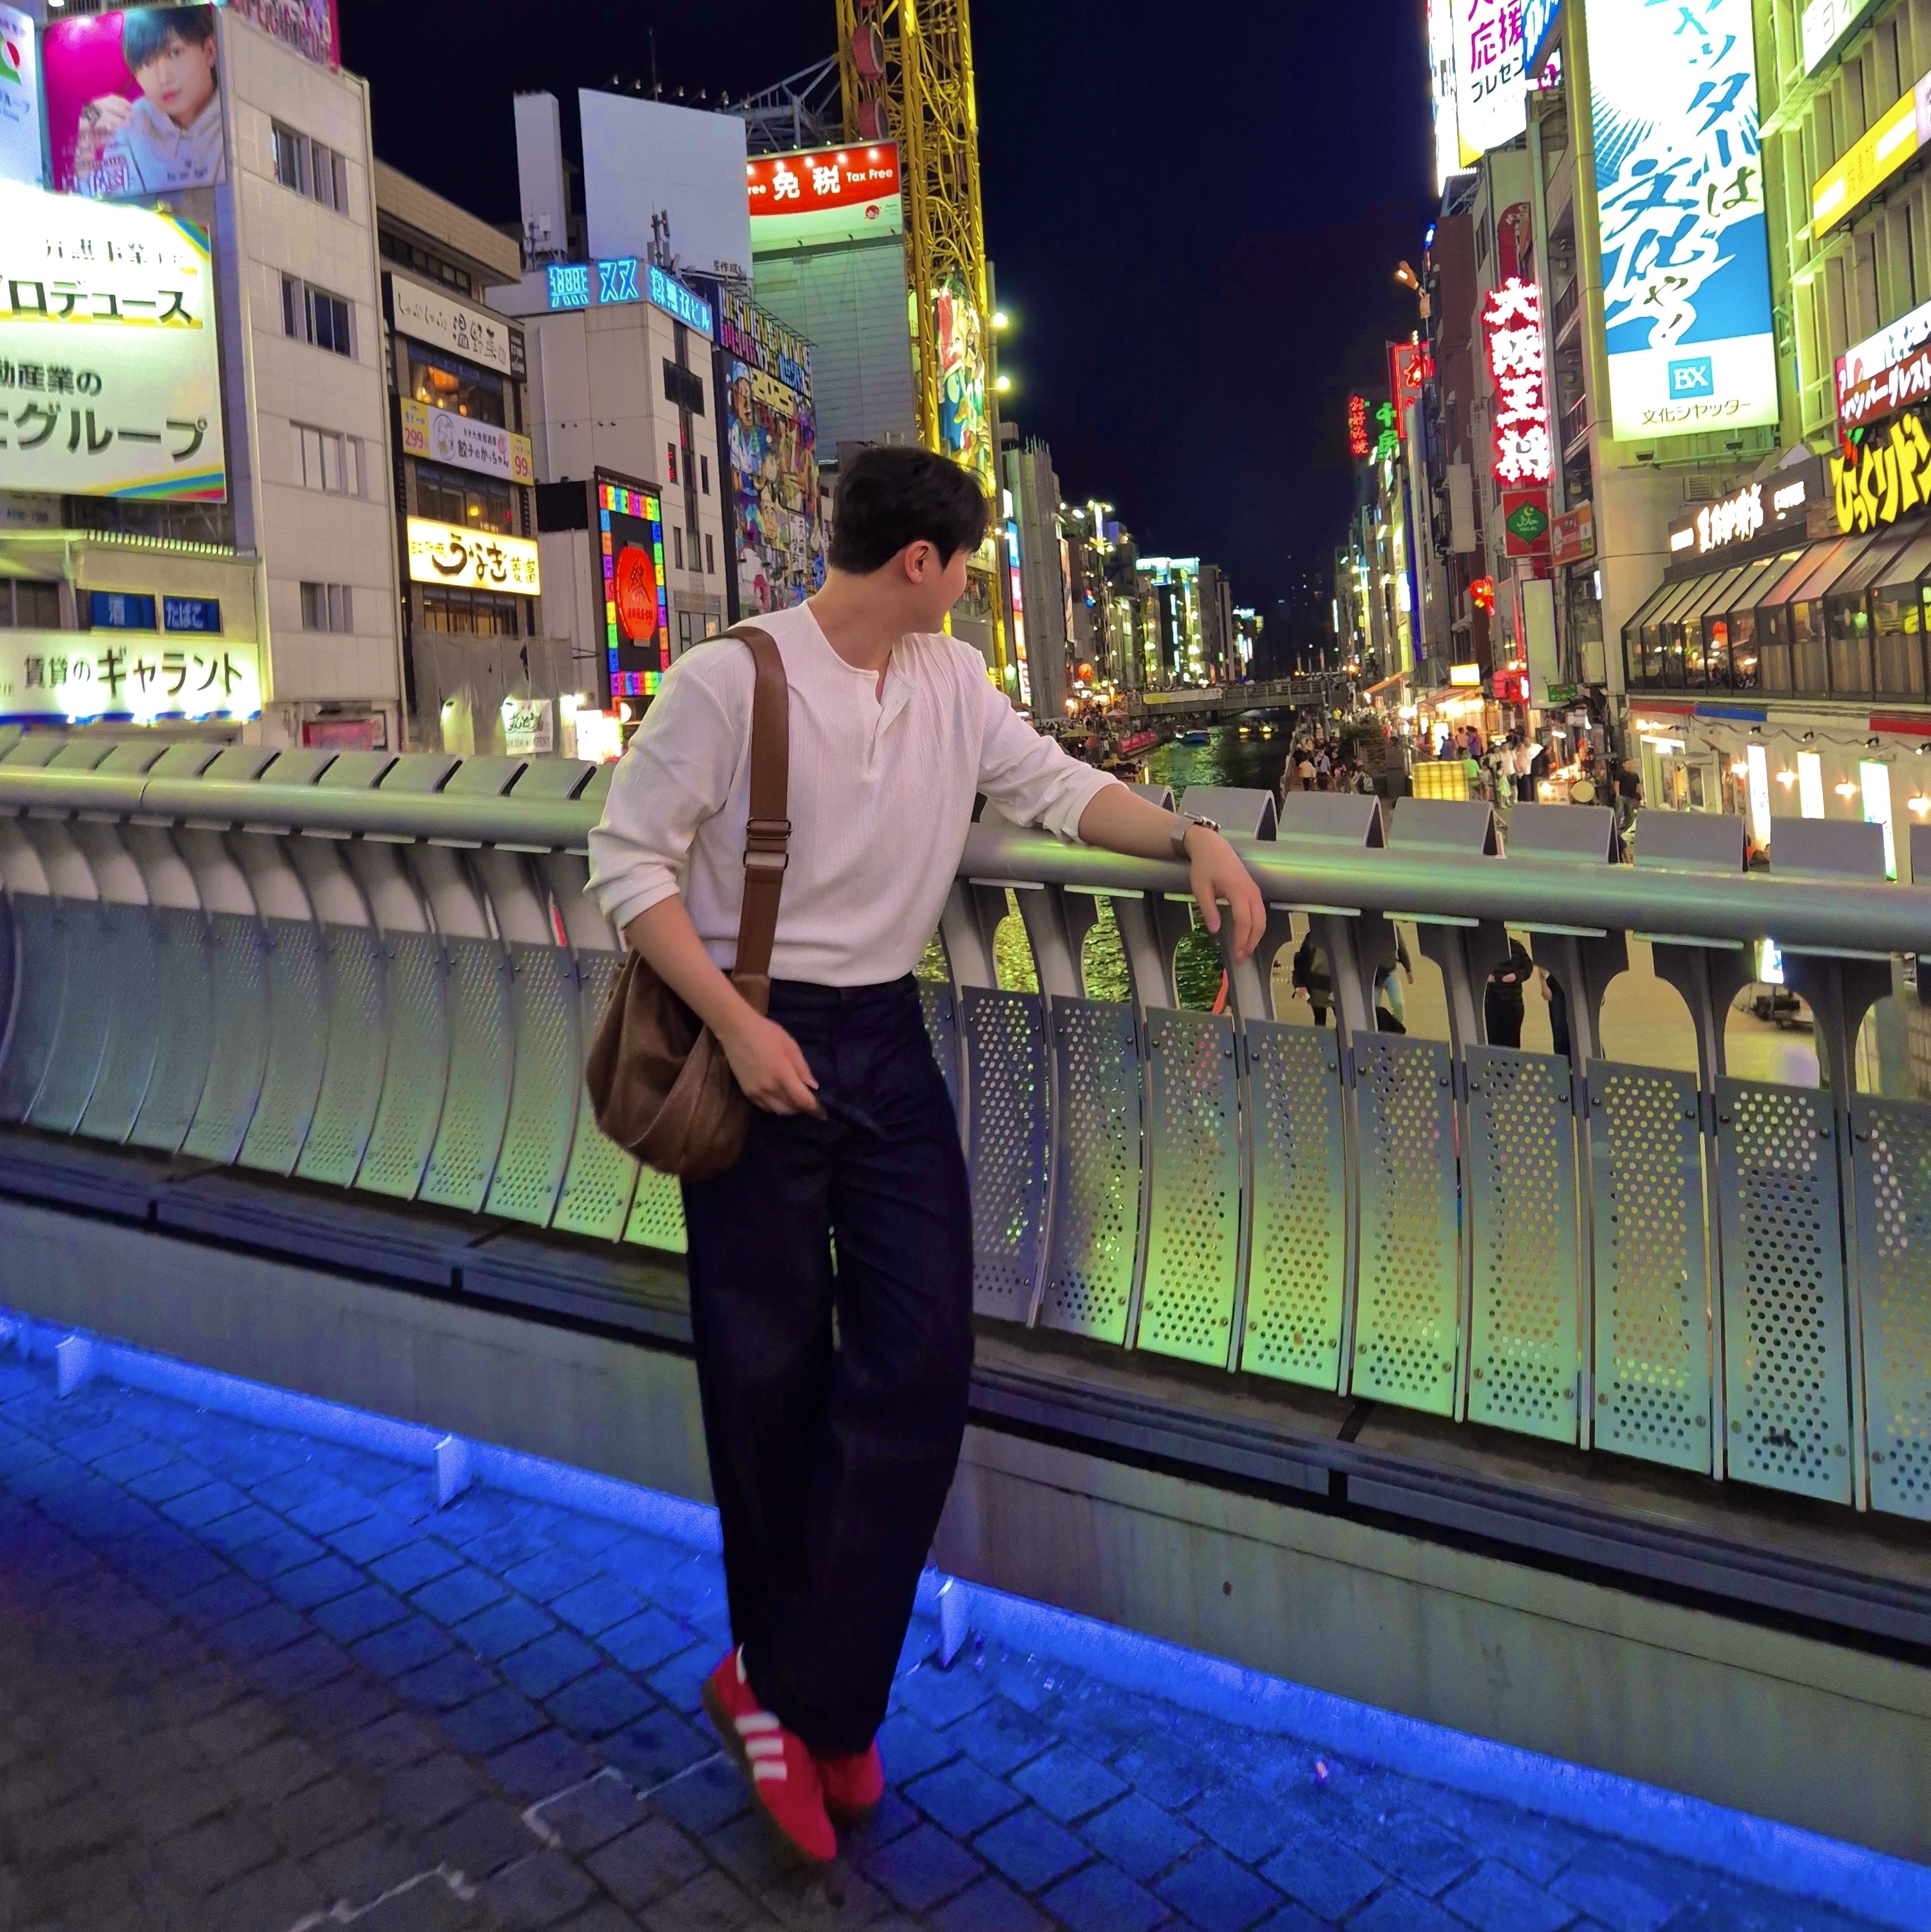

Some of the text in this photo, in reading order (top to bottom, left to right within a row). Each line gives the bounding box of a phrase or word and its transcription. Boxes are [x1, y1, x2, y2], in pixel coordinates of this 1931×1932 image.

[773, 165, 841, 201] 免税
[847, 167, 893, 183] Tax Free
[748, 185, 766, 196] ree
[548, 258, 639, 308] 無双
[0, 274, 193, 325] ロデュース
[1484, 276, 1550, 483] 大阪王将
[1673, 366, 1708, 390] BX
[0, 400, 207, 462] グループ
[404, 427, 424, 450] 299
[514, 455, 529, 477] 99
